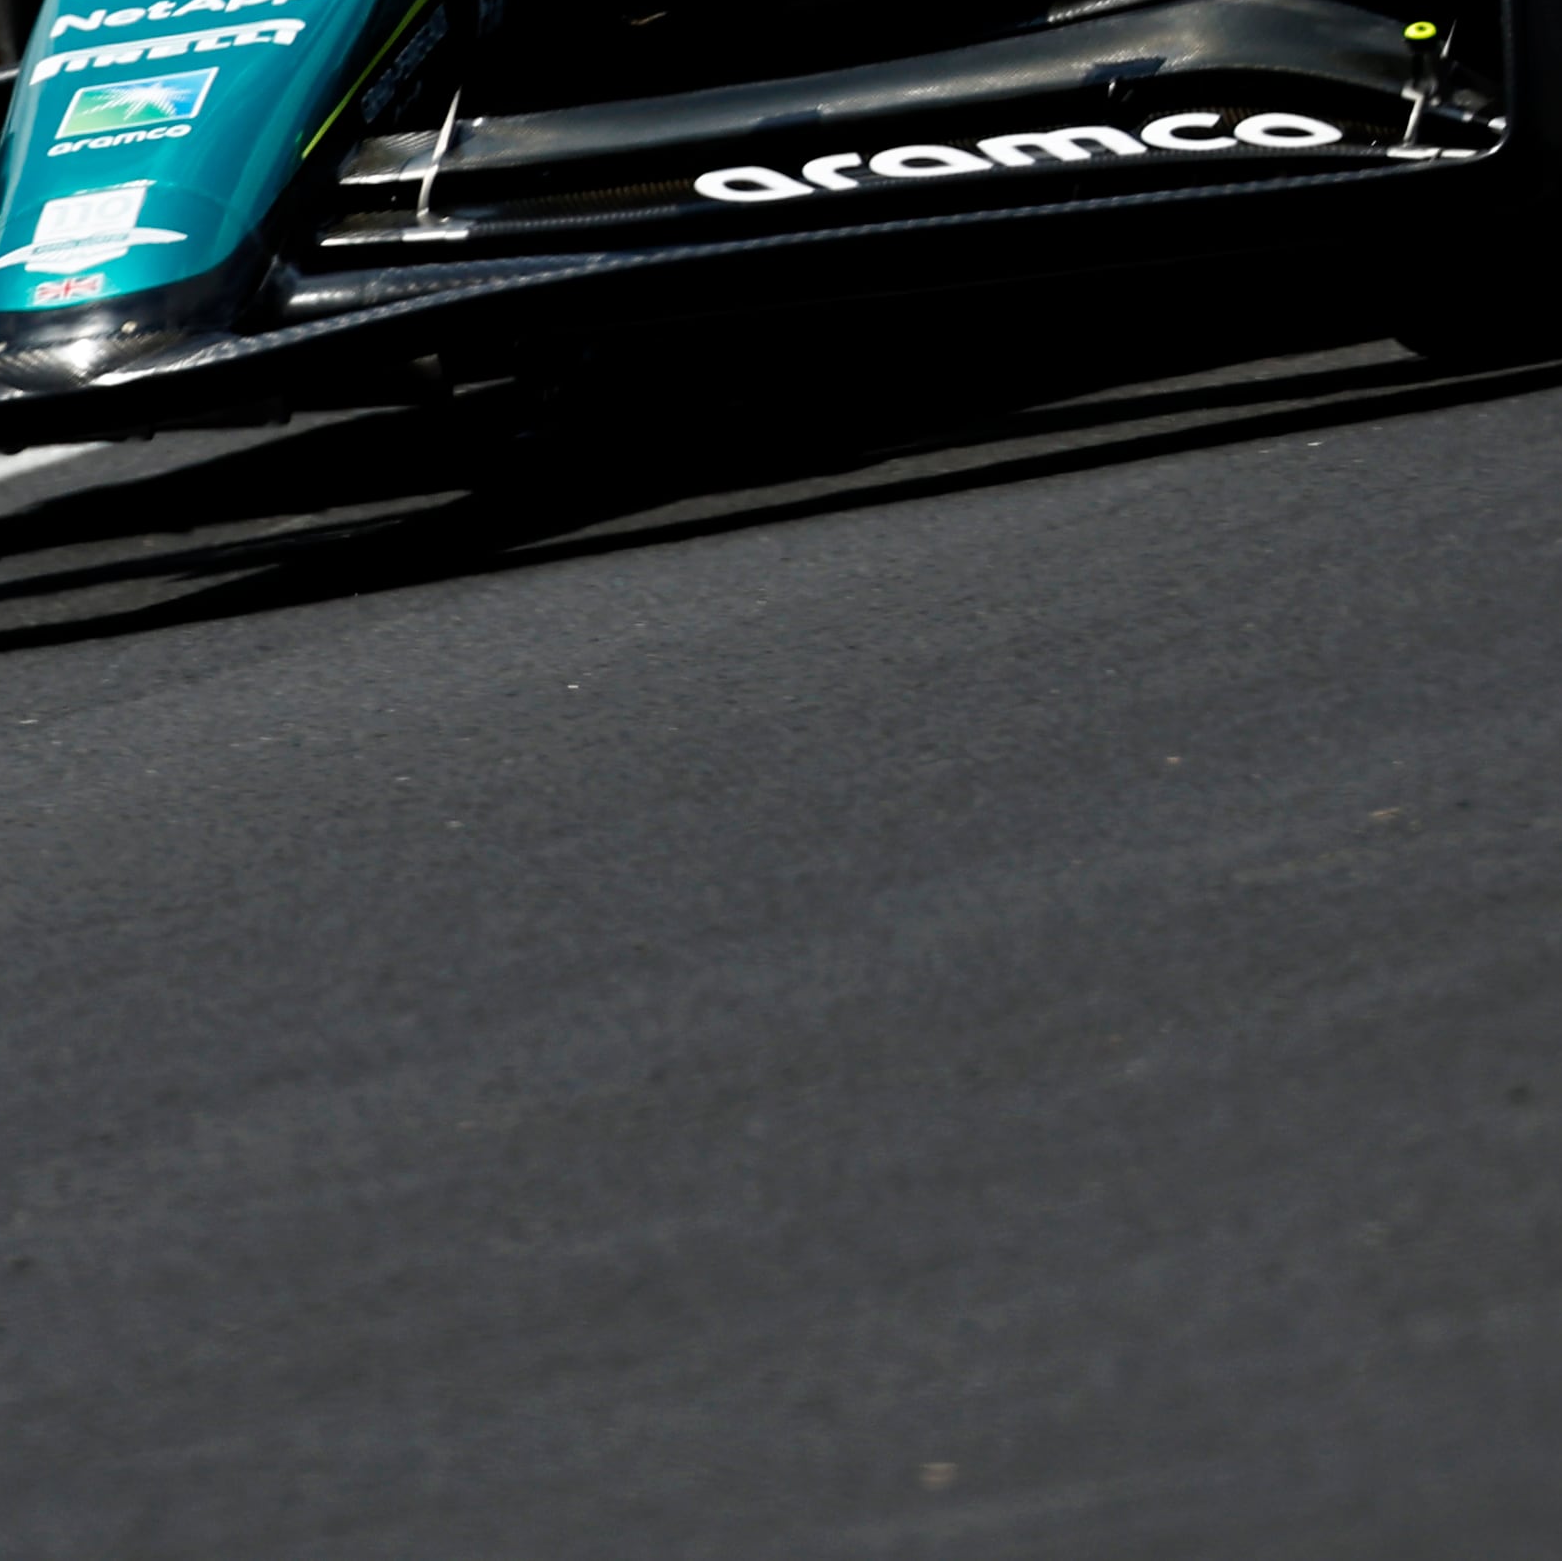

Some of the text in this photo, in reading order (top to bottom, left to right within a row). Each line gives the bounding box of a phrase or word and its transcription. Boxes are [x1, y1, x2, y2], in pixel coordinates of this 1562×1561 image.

[29, 17, 307, 87] PIRELLI
[46, 123, 193, 158] aramco
[693, 111, 1343, 204] aramco
